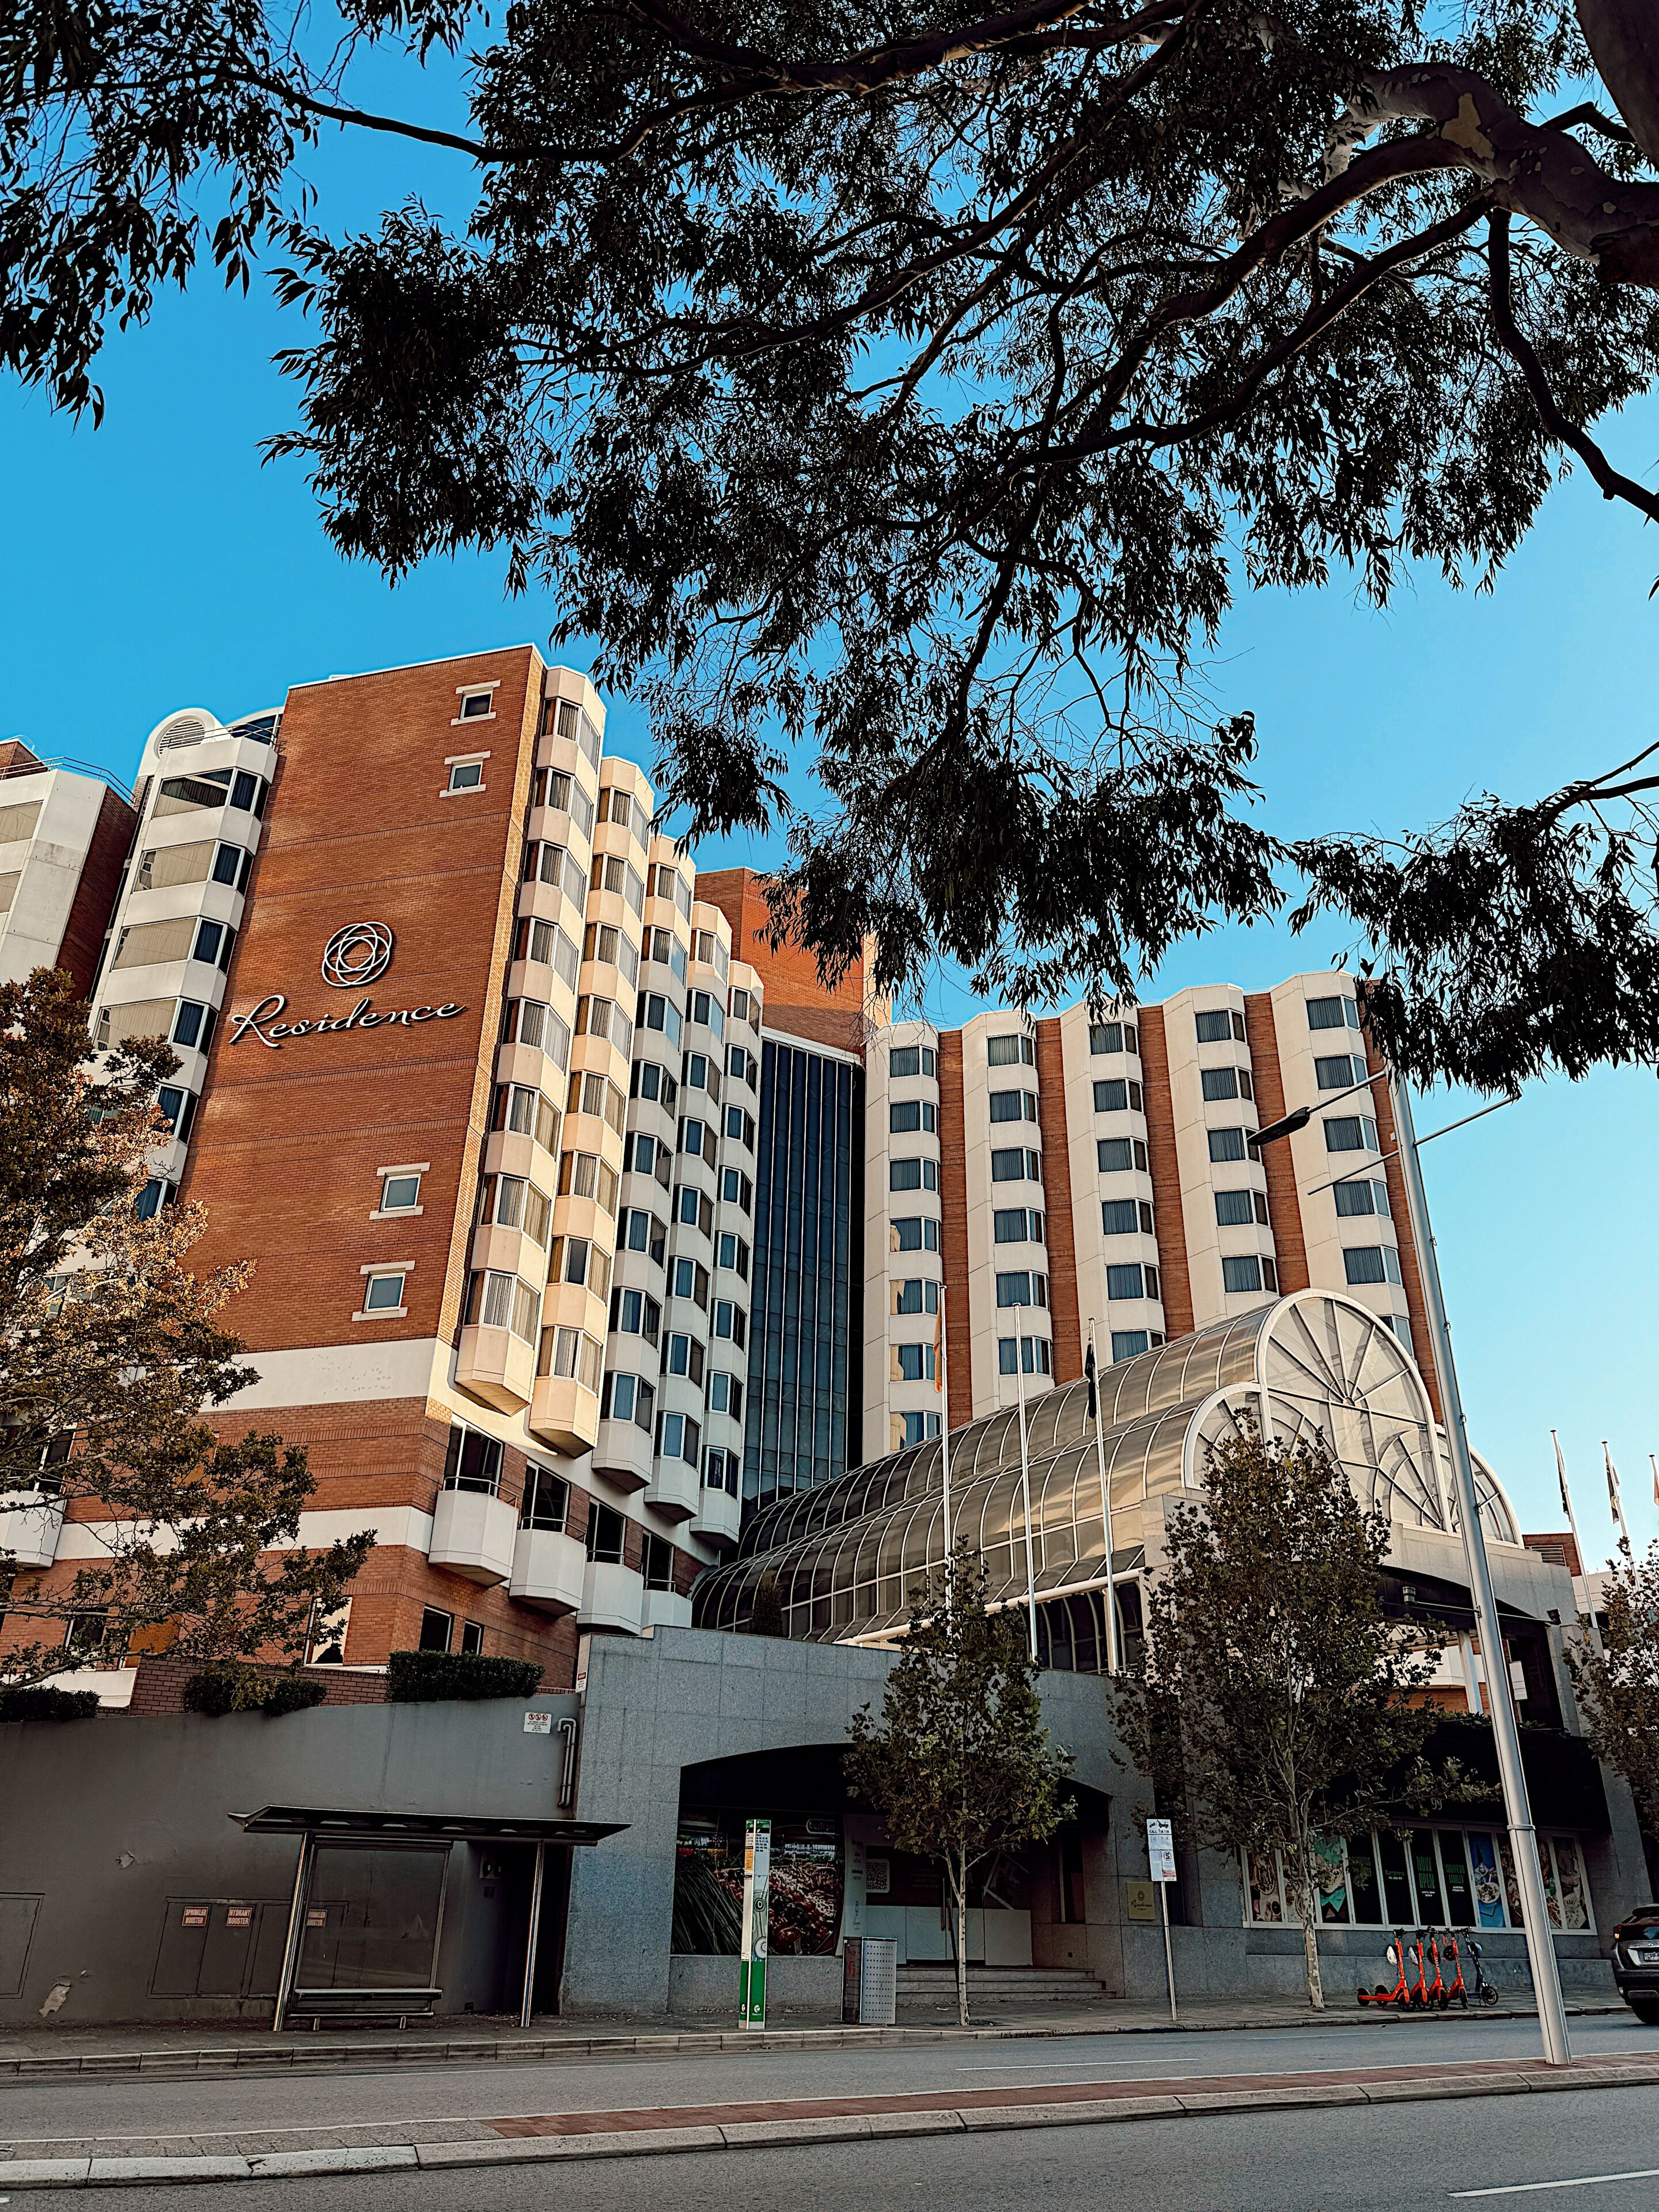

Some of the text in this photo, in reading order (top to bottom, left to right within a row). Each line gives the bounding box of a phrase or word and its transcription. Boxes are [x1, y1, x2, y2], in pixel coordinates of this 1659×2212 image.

[229, 995, 467, 1047] Residence
[1431, 1798, 1442, 1810] 99
[1418, 1873, 1435, 1889] OPEN
